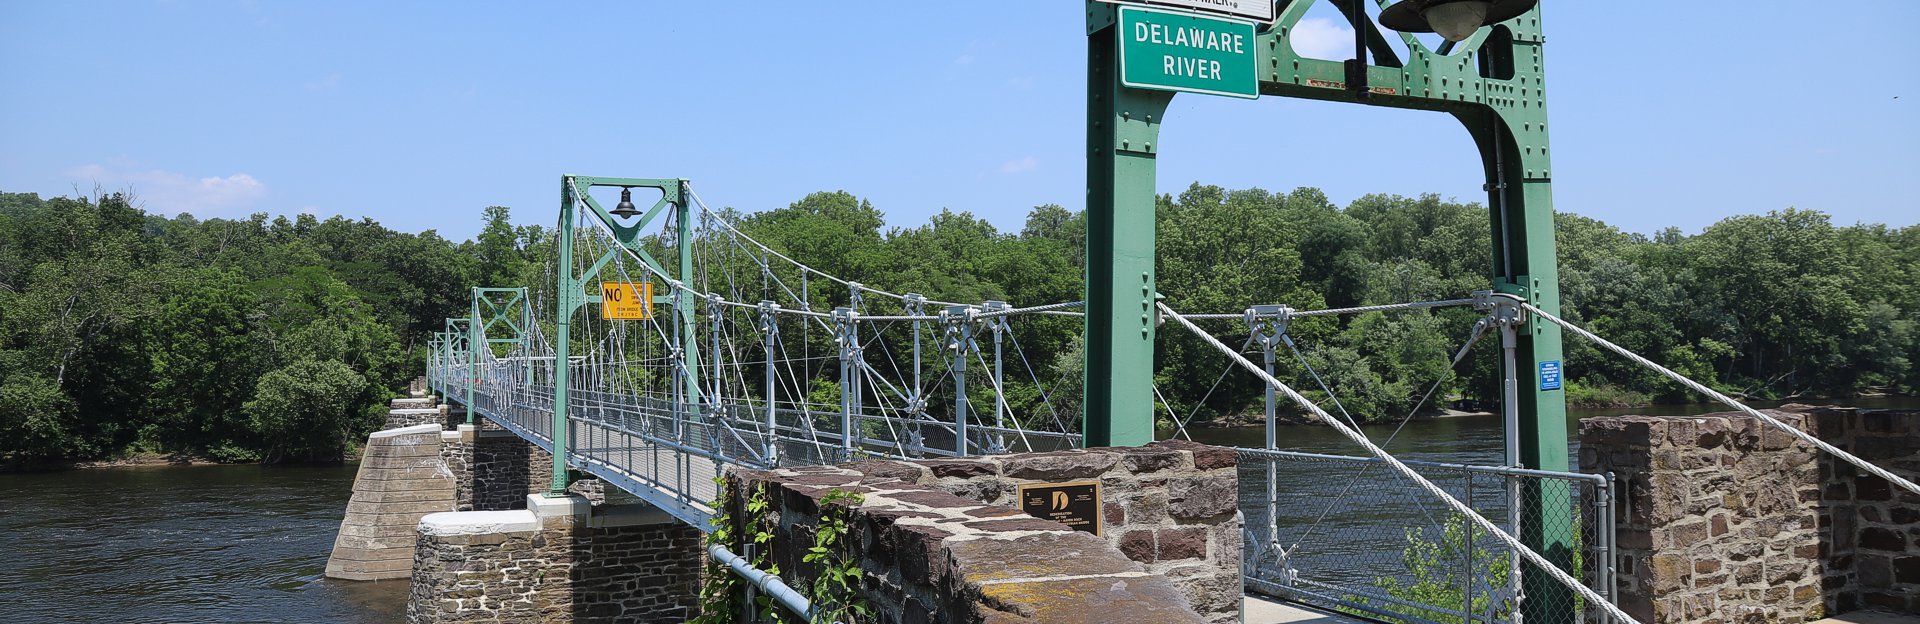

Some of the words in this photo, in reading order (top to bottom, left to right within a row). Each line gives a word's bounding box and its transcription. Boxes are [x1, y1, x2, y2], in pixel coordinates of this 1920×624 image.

[1135, 22, 1244, 54] DELAWARE
[1163, 55, 1222, 81] RIVER
[605, 288, 622, 302] NO
